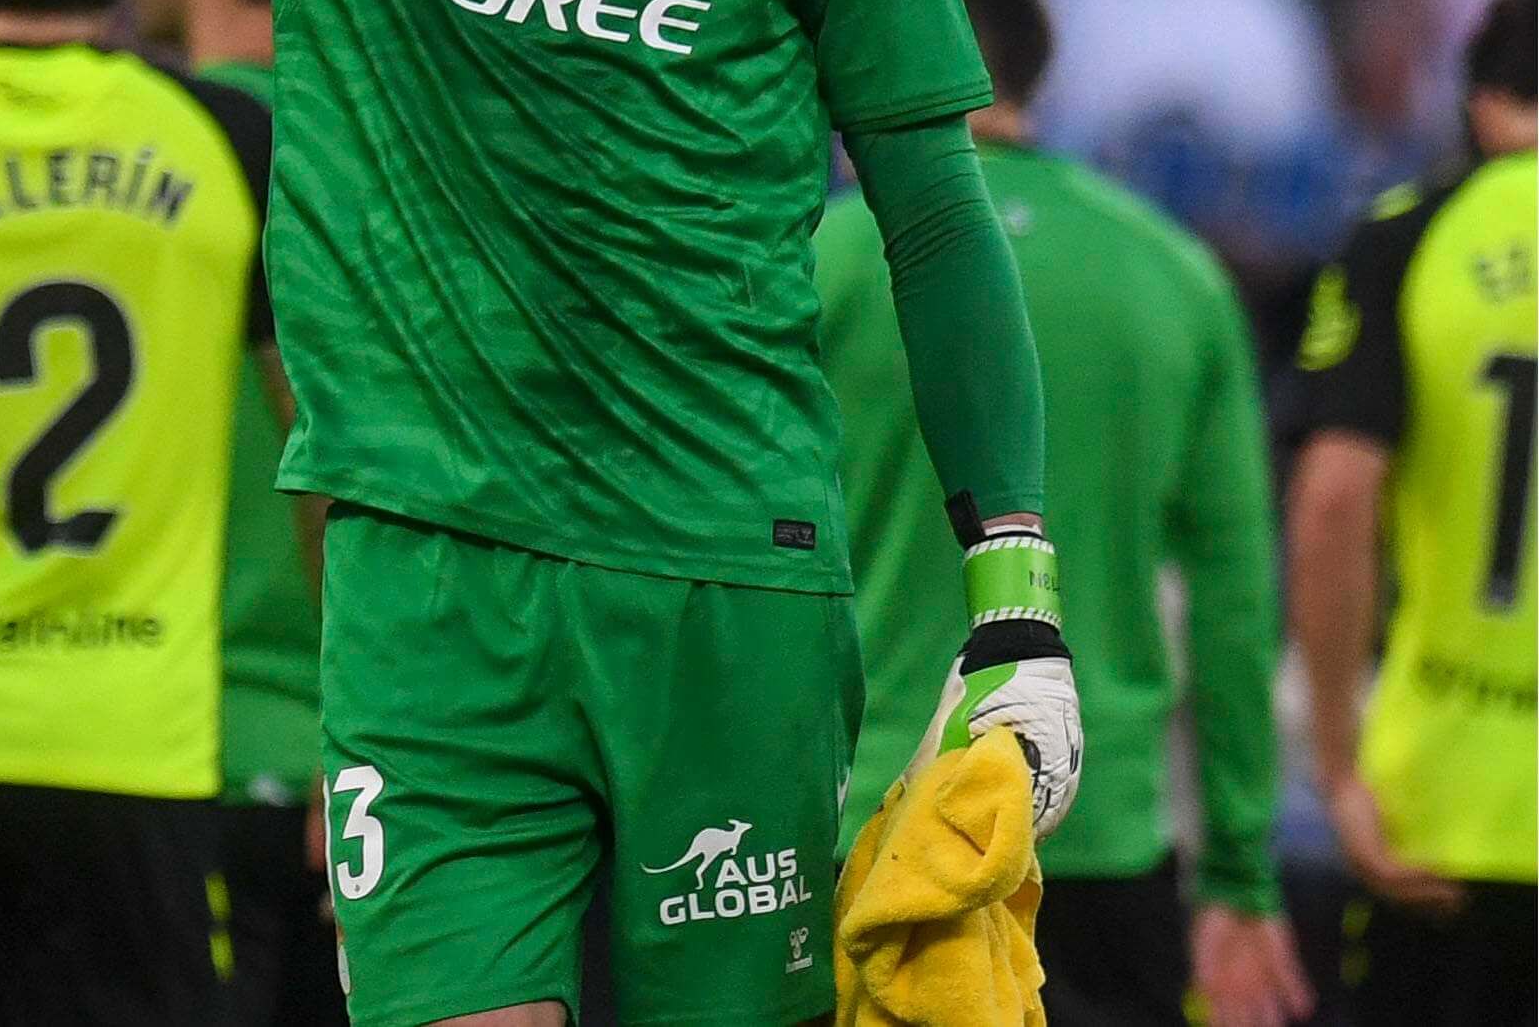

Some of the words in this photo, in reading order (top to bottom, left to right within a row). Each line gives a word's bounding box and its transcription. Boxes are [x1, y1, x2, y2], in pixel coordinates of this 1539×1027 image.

[324, 765, 385, 902] 3
[714, 848, 797, 889] AUS
[659, 875, 812, 925] GLOBAL
